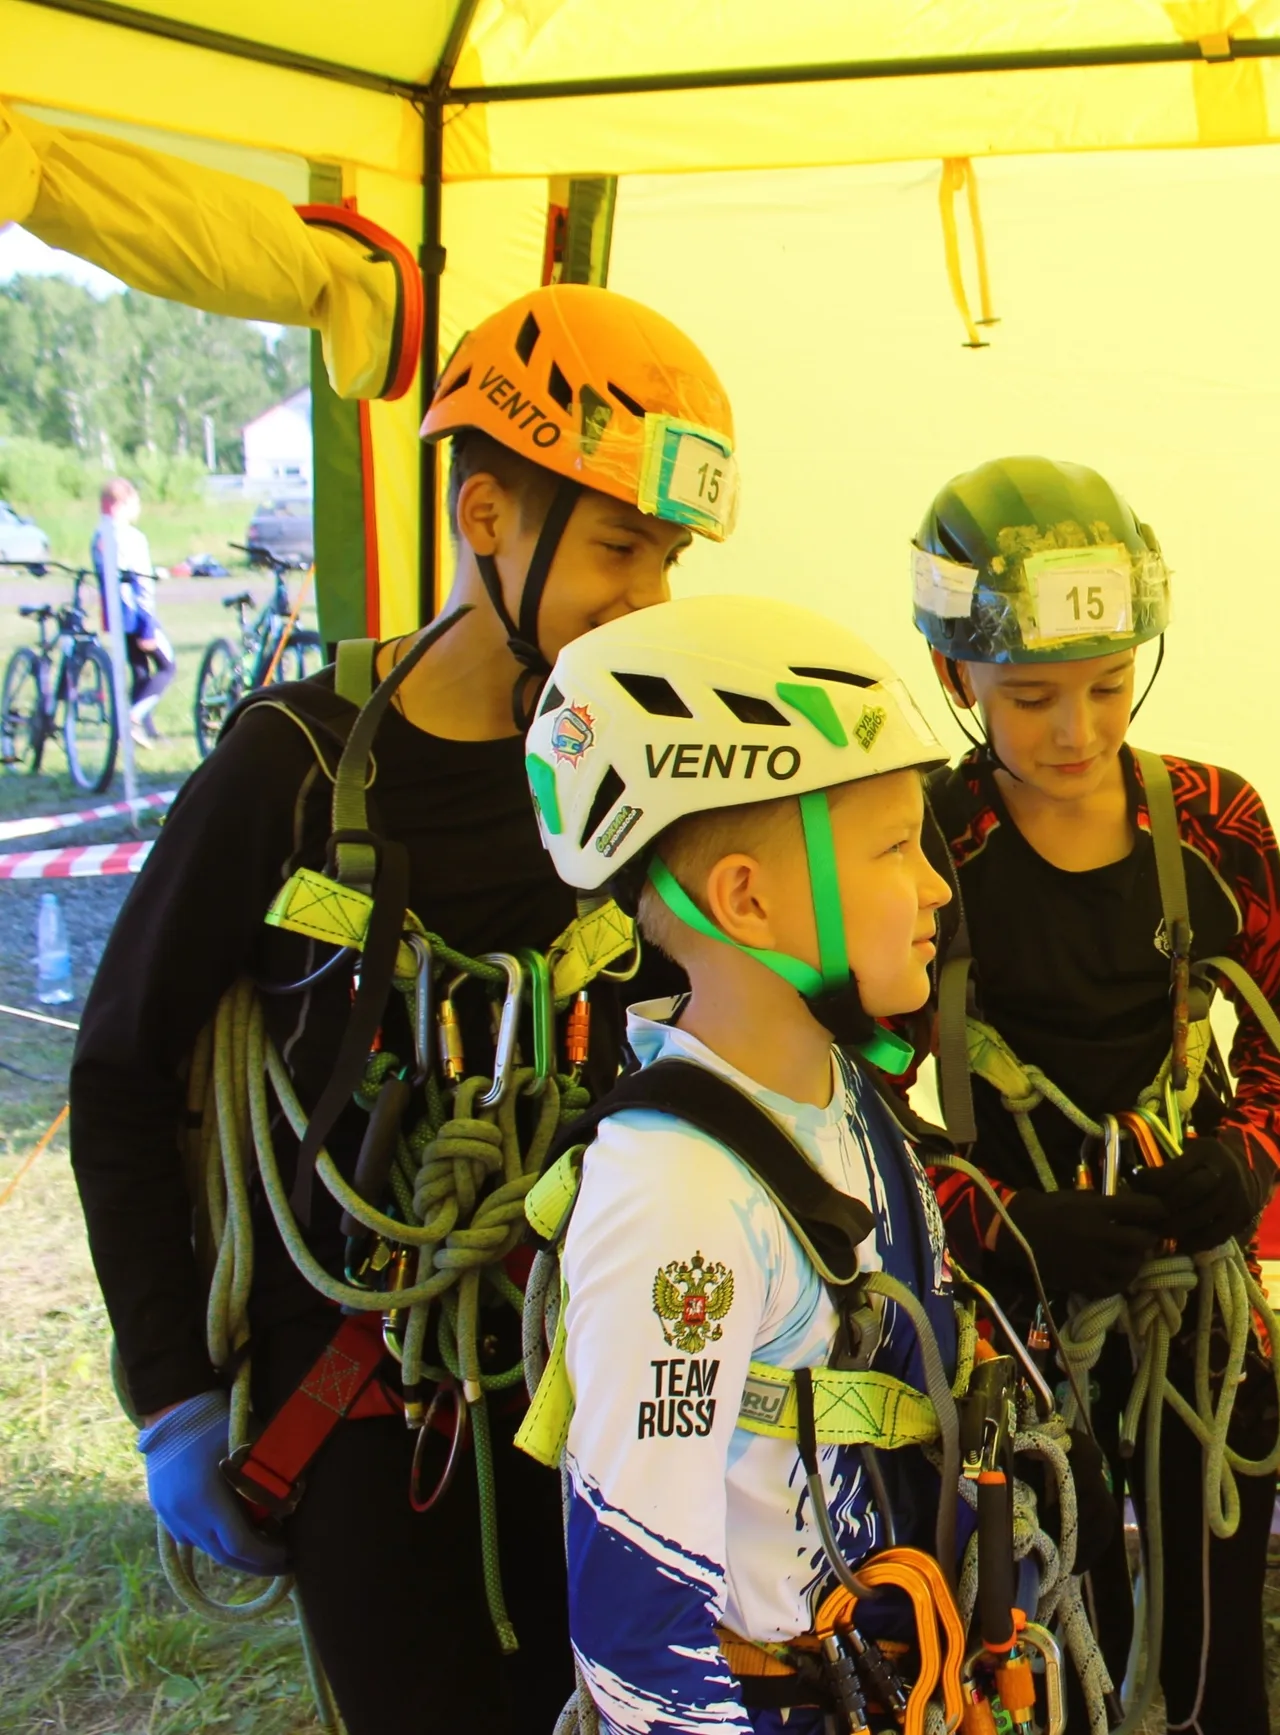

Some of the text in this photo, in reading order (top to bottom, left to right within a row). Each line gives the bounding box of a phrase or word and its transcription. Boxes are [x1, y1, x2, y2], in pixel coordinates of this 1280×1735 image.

[478, 366, 561, 449] VENTO
[697, 462, 723, 504] 15
[1065, 586, 1104, 621] 15
[855, 714, 873, 739] гуд
[645, 743, 801, 781] VENTO
